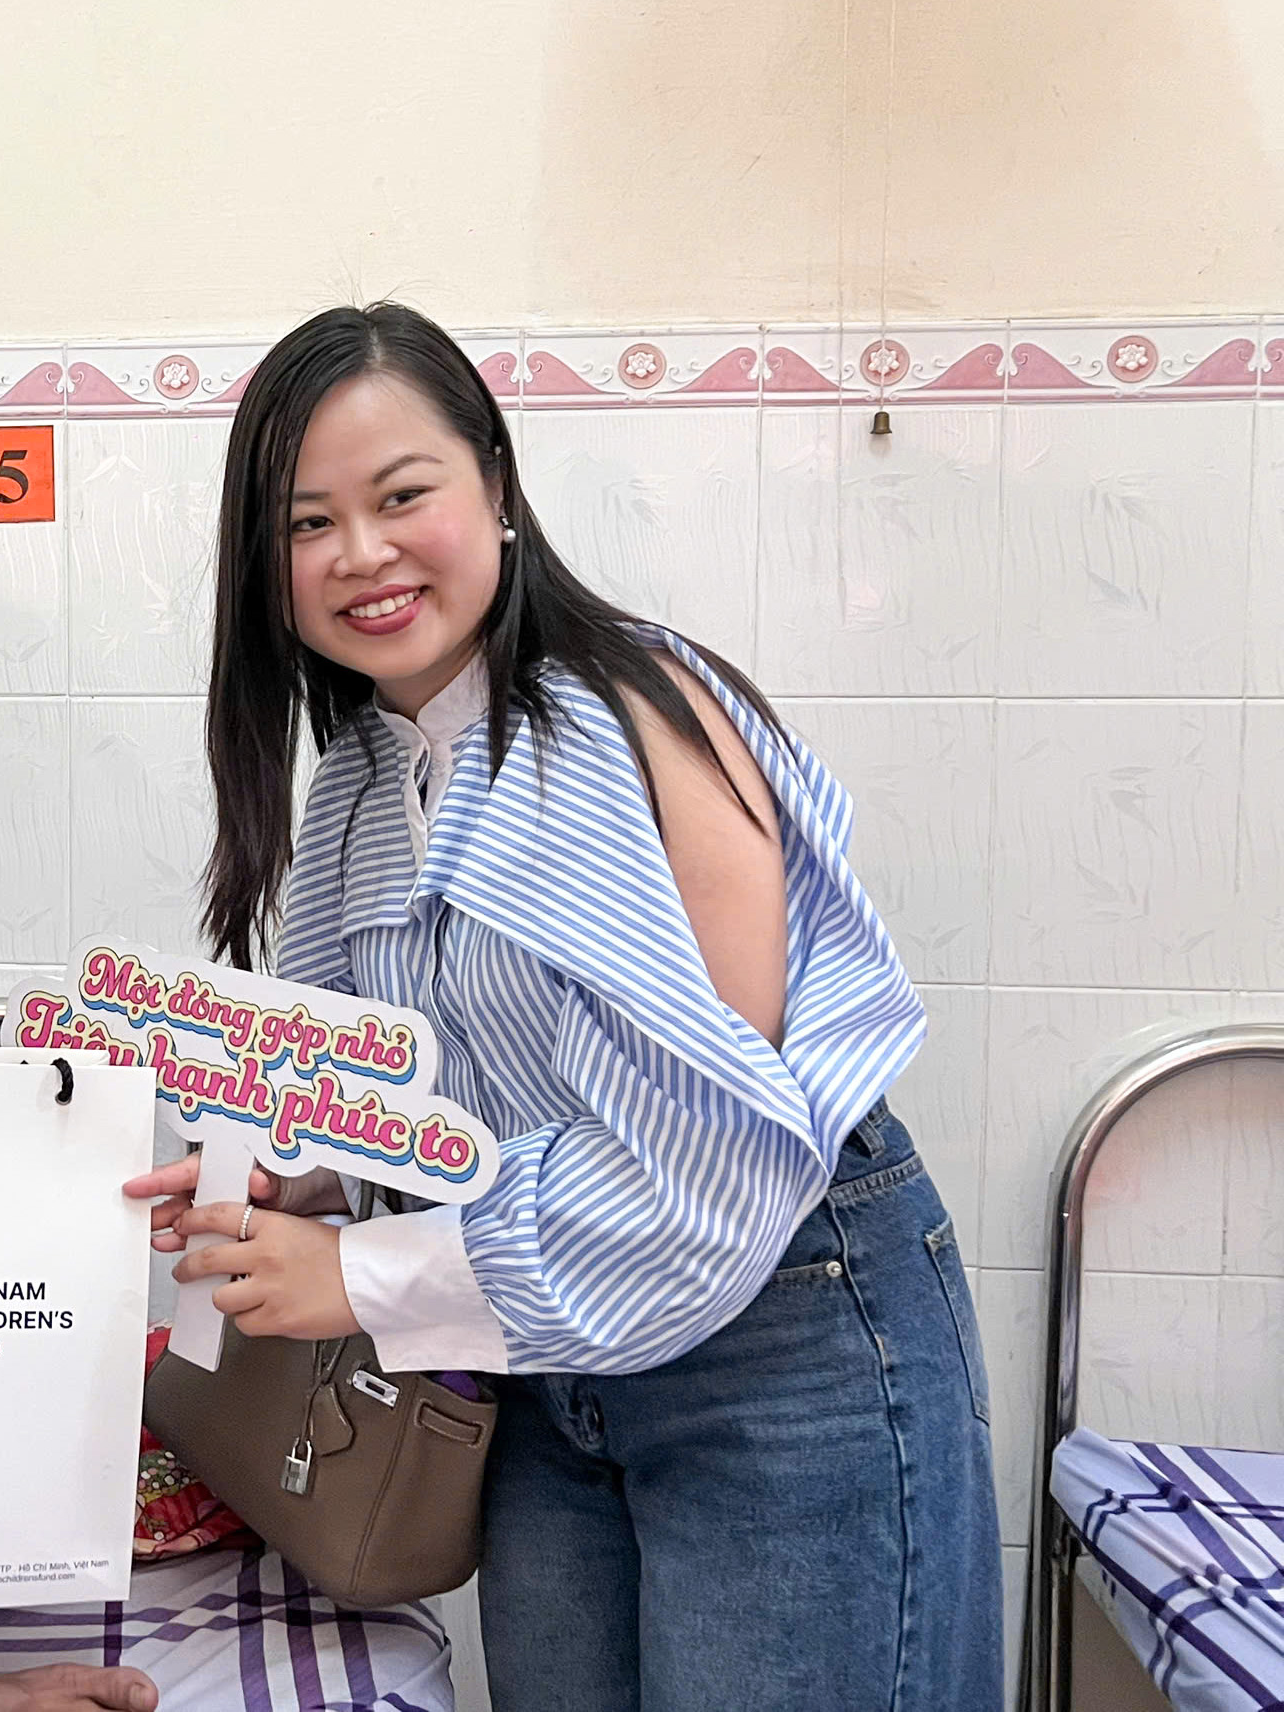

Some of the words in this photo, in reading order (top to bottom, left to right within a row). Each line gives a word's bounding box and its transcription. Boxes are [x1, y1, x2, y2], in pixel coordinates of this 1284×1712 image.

[83, 953, 163, 1015] Một
[167, 978, 256, 1048] đóng
[258, 1011, 327, 1065] góp
[334, 1021, 407, 1069] nhỏ
[149, 1034, 270, 1113] hạnh
[275, 1076, 406, 1151] phúc
[418, 1120, 470, 1168] to
